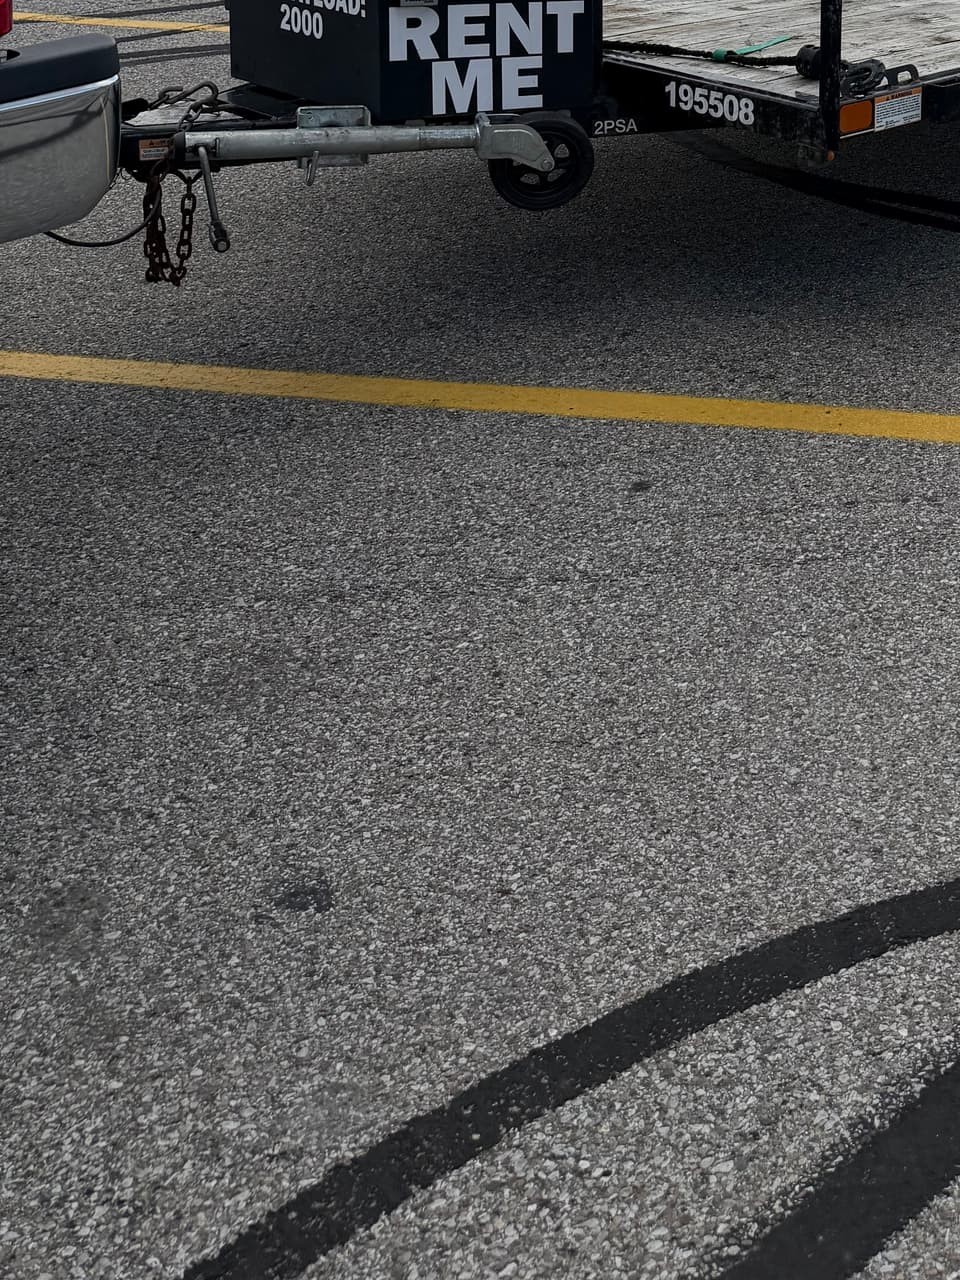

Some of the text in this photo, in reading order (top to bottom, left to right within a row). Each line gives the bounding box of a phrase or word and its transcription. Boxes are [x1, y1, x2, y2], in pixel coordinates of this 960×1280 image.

[280, 3, 323, 40] 2000
[388, 0, 585, 61] RENT
[431, 56, 544, 115] ME
[664, 81, 755, 126] 195508
[594, 118, 638, 135] 2PSA
